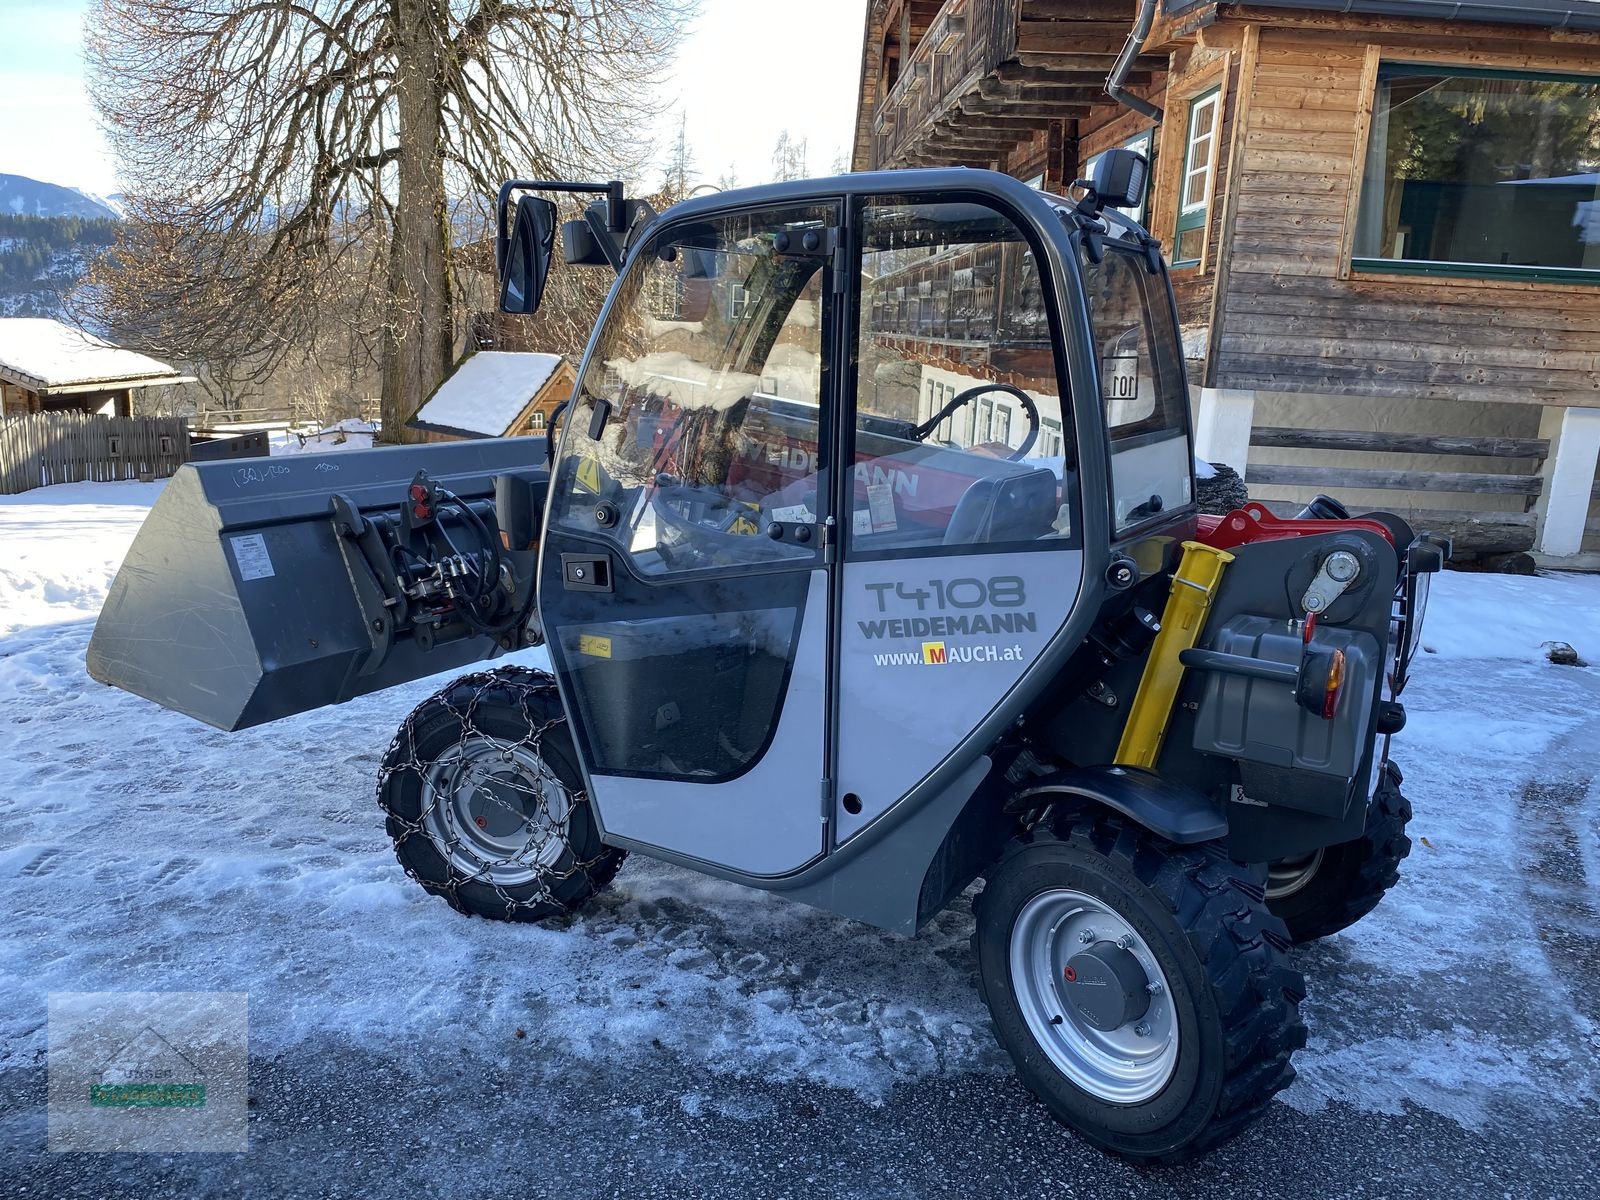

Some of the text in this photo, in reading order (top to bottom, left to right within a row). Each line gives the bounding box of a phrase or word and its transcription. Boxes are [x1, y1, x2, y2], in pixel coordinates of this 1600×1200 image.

[864, 575, 1027, 612] T4108
[857, 611, 1037, 640] WEIDEMANN
[873, 641, 1023, 666] www.MAUCH.at
